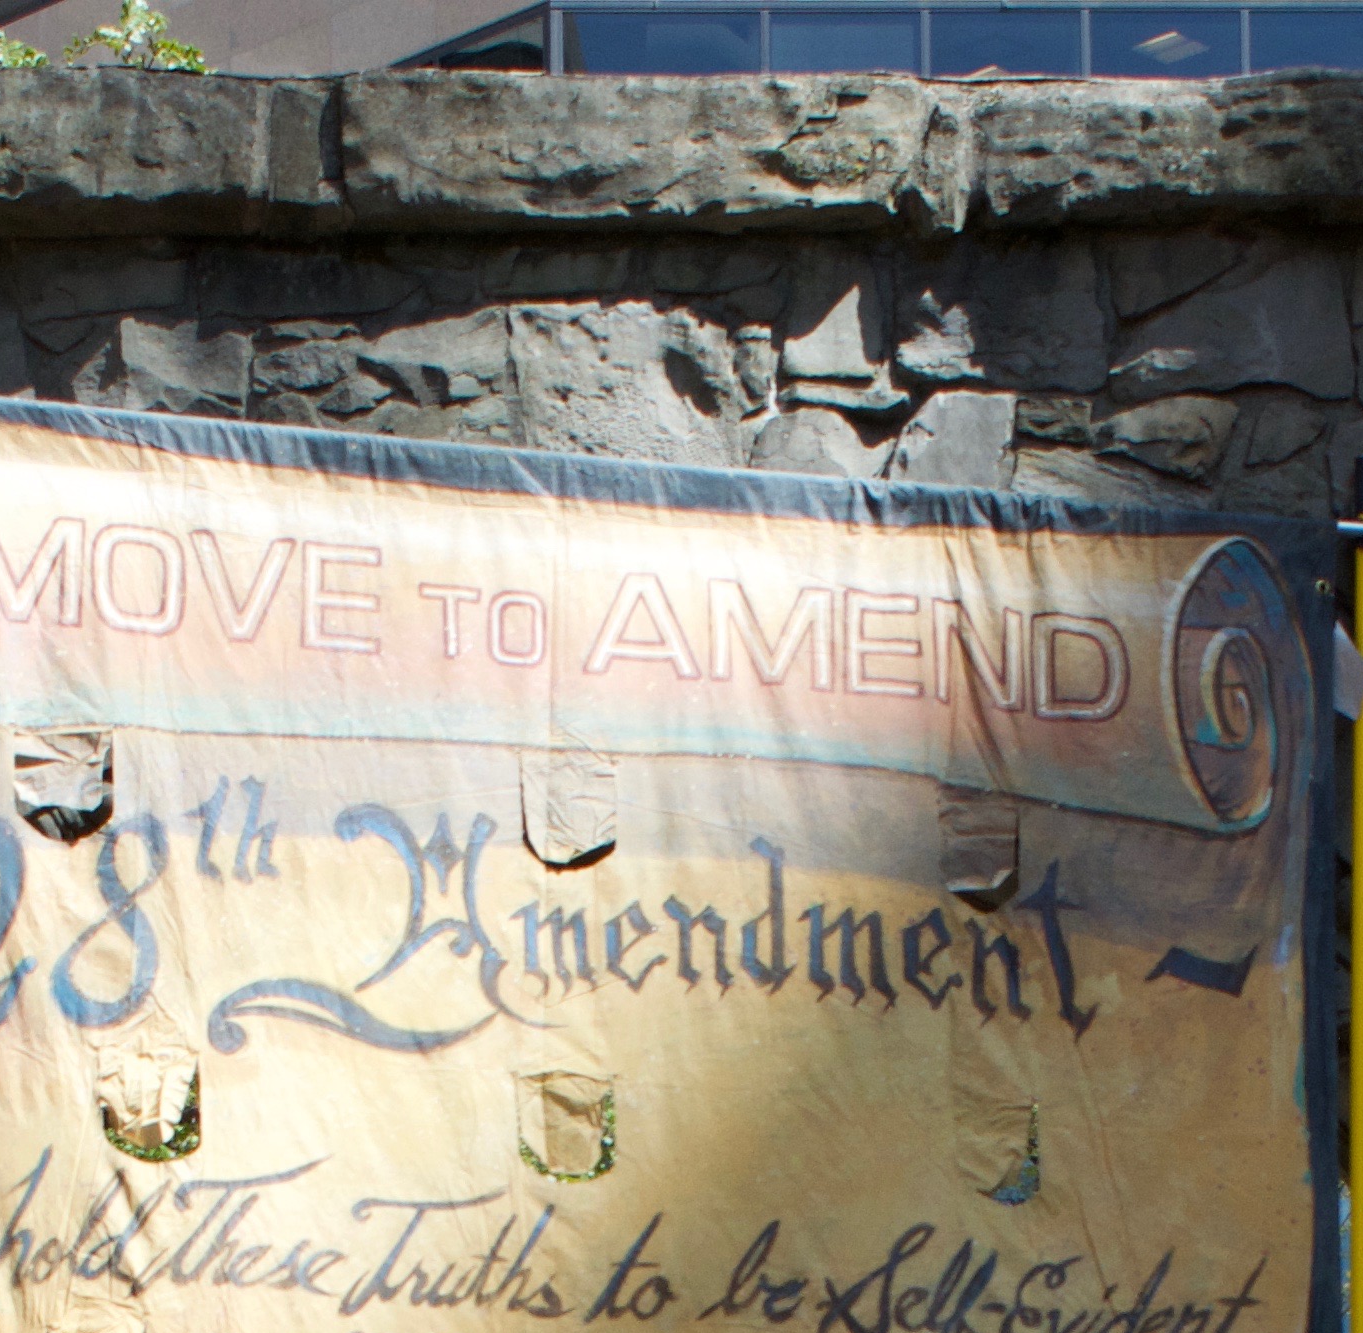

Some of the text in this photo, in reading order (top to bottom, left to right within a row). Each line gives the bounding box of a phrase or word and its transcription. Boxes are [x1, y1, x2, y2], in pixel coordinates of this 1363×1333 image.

[420, 581, 548, 667] TO
[583, 571, 1129, 723] AMEND
[208, 802, 1098, 1050] Amendment
[136, 1155, 353, 1296] These
[339, 1190, 565, 1317] Truths
[584, 1211, 676, 1325] to
[698, 1220, 812, 1325] be
